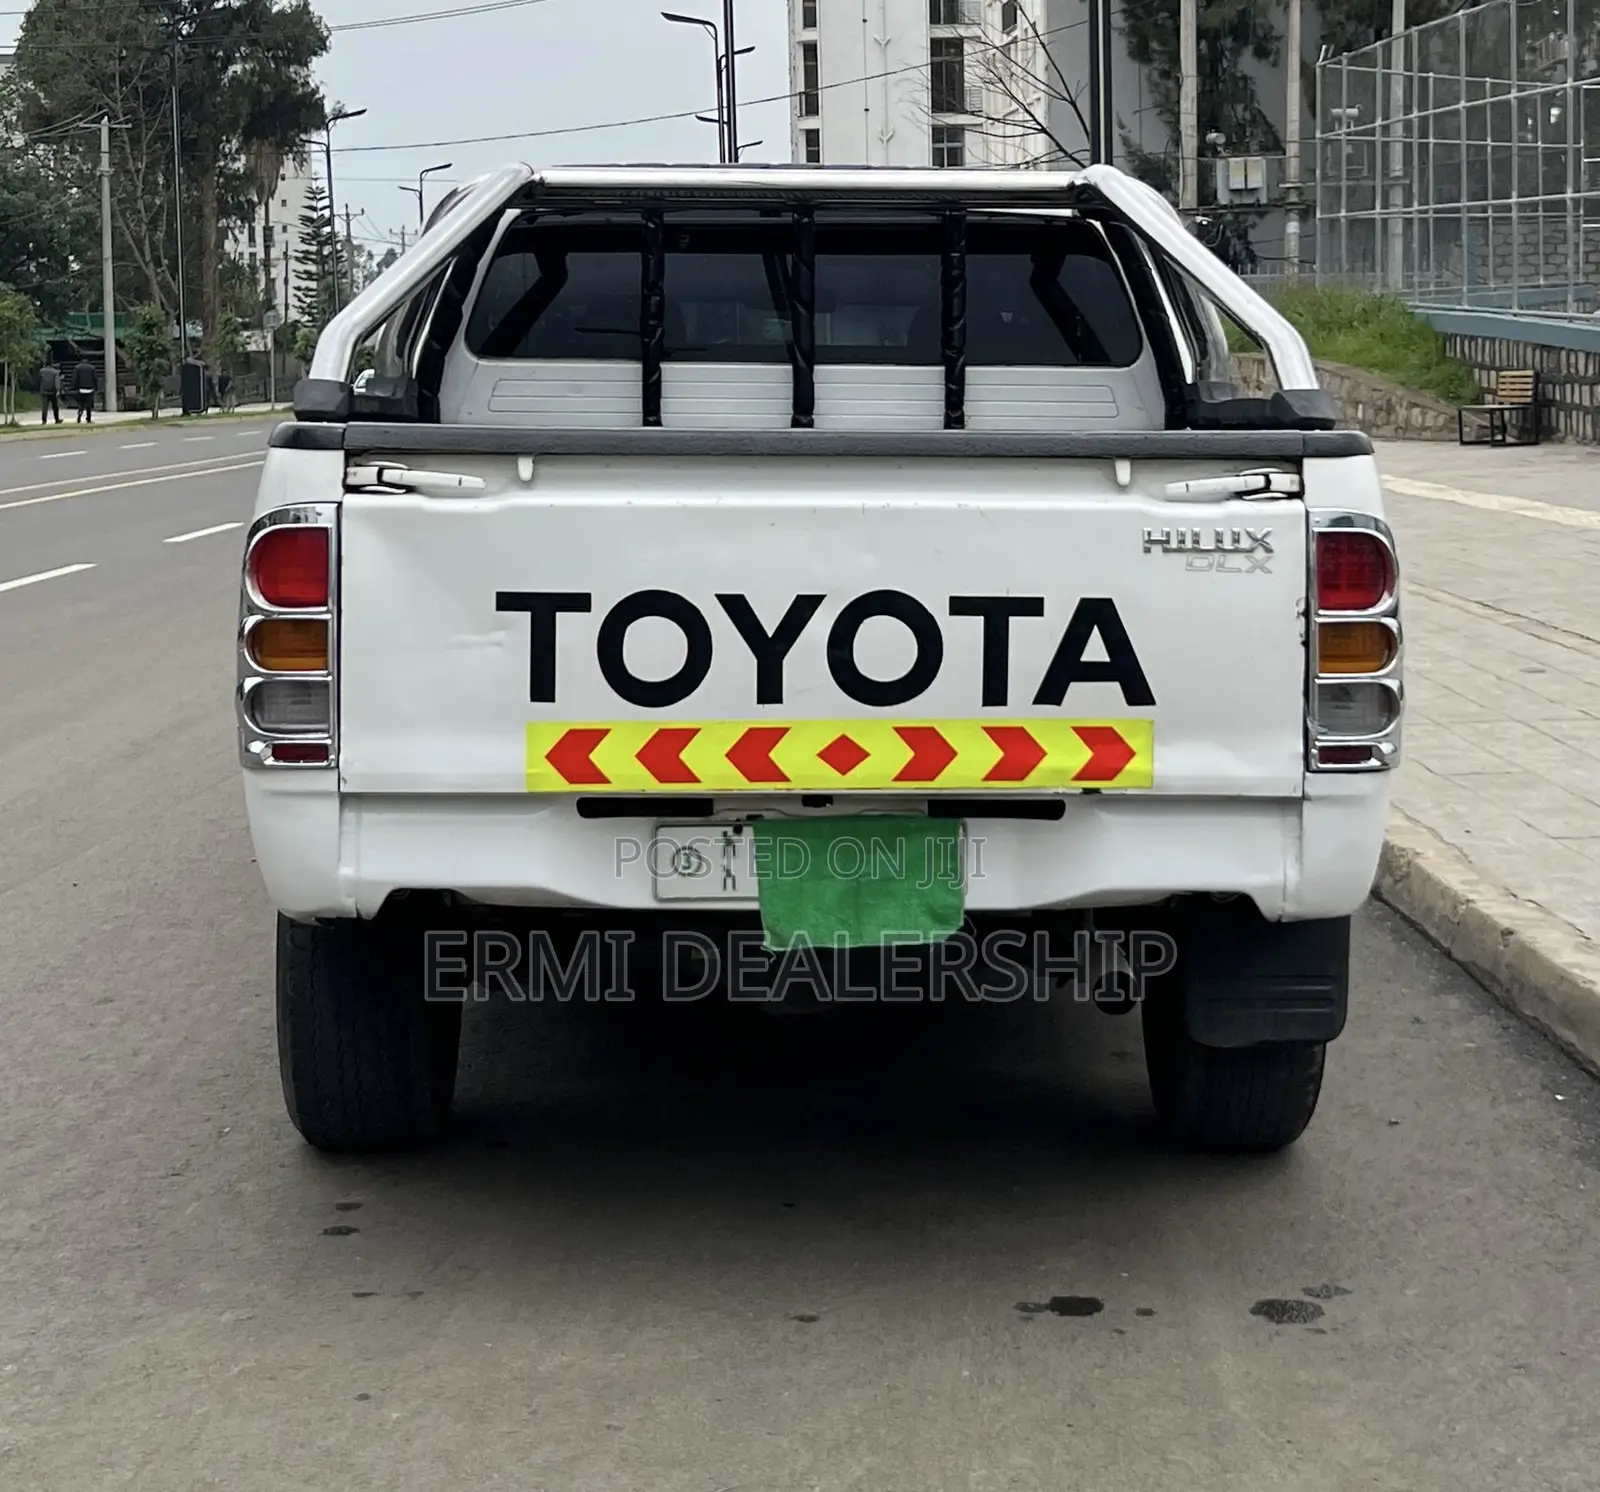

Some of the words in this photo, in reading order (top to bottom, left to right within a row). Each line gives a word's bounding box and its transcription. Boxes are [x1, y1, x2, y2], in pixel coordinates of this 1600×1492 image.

[1142, 527, 1274, 554] HILUX
[1185, 554, 1273, 574] DLX
[496, 588, 1156, 706] TOYOTA
